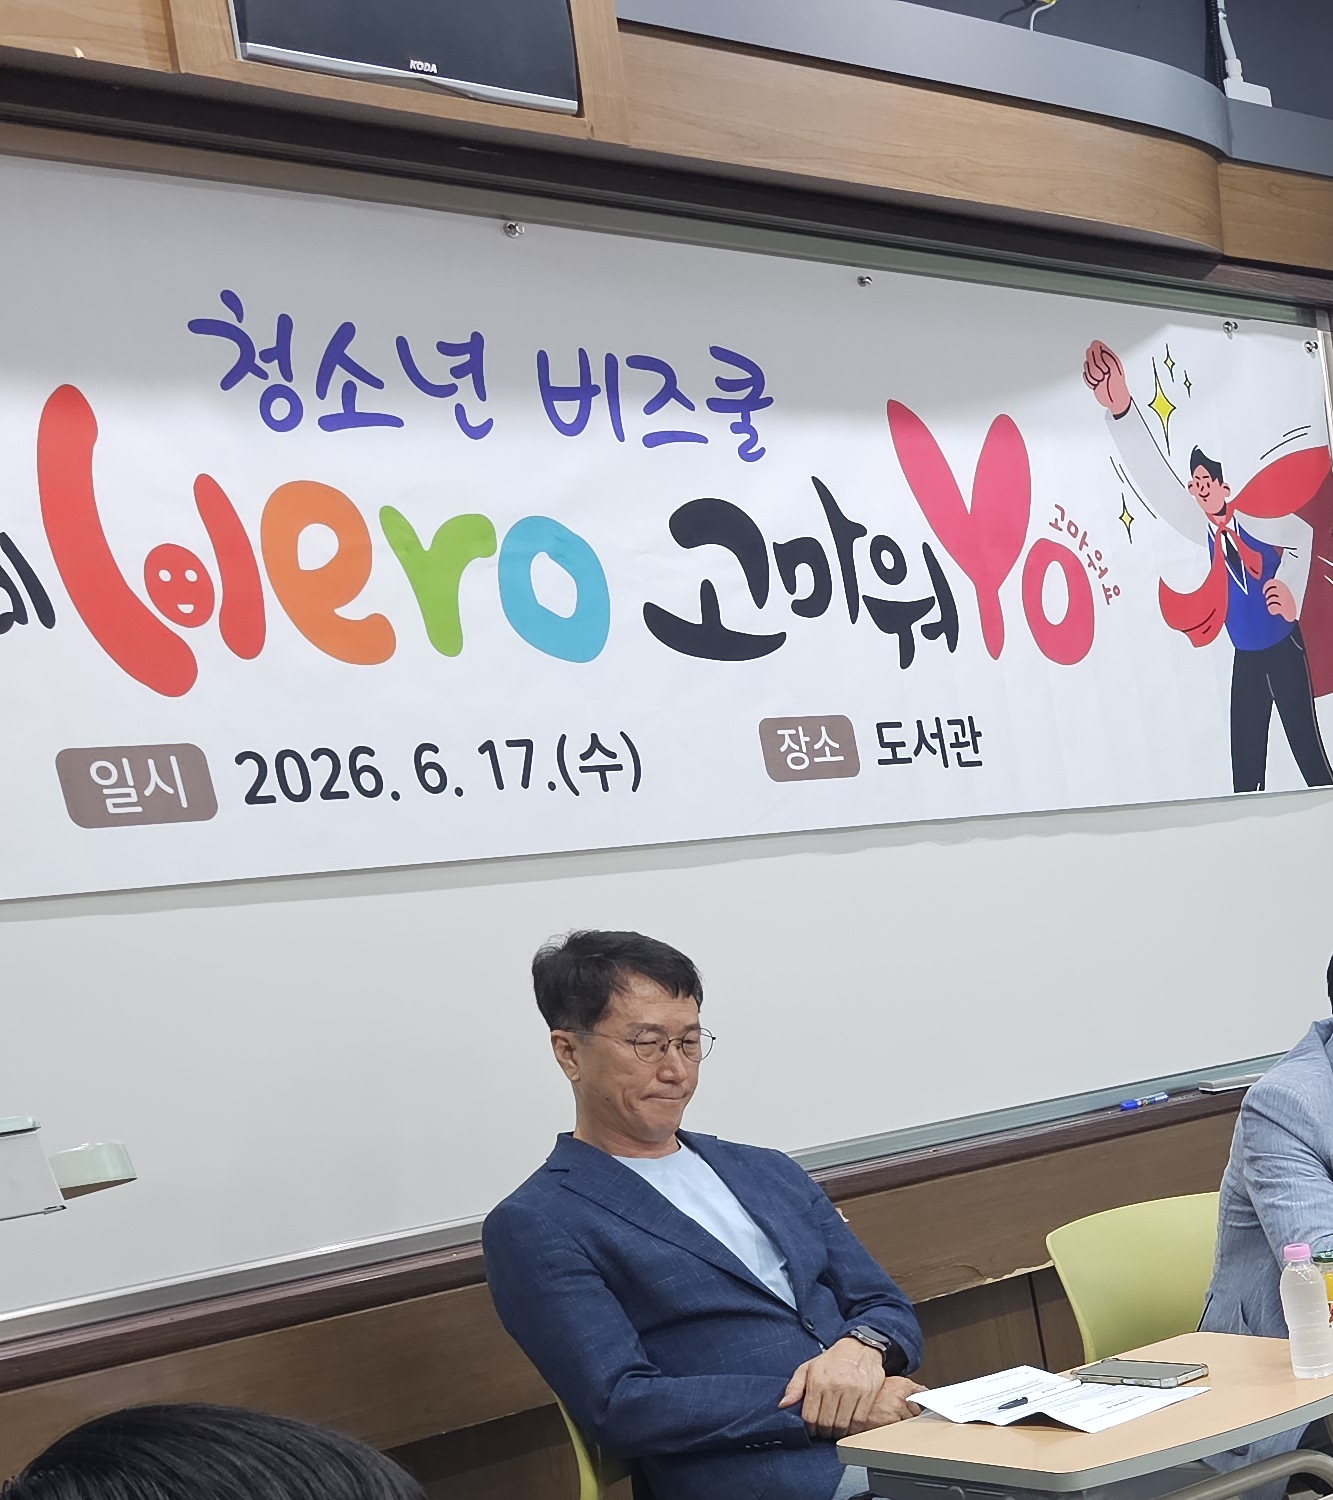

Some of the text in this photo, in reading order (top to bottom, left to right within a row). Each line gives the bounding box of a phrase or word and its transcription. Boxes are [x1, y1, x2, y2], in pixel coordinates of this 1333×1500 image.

[409, 59, 438, 74] KODA
[187, 288, 775, 463] 청소년 비즈쿨
[88, 730, 645, 814] 일시 2026. 6. 17.(수)
[776, 715, 983, 772] 장소 도서관
